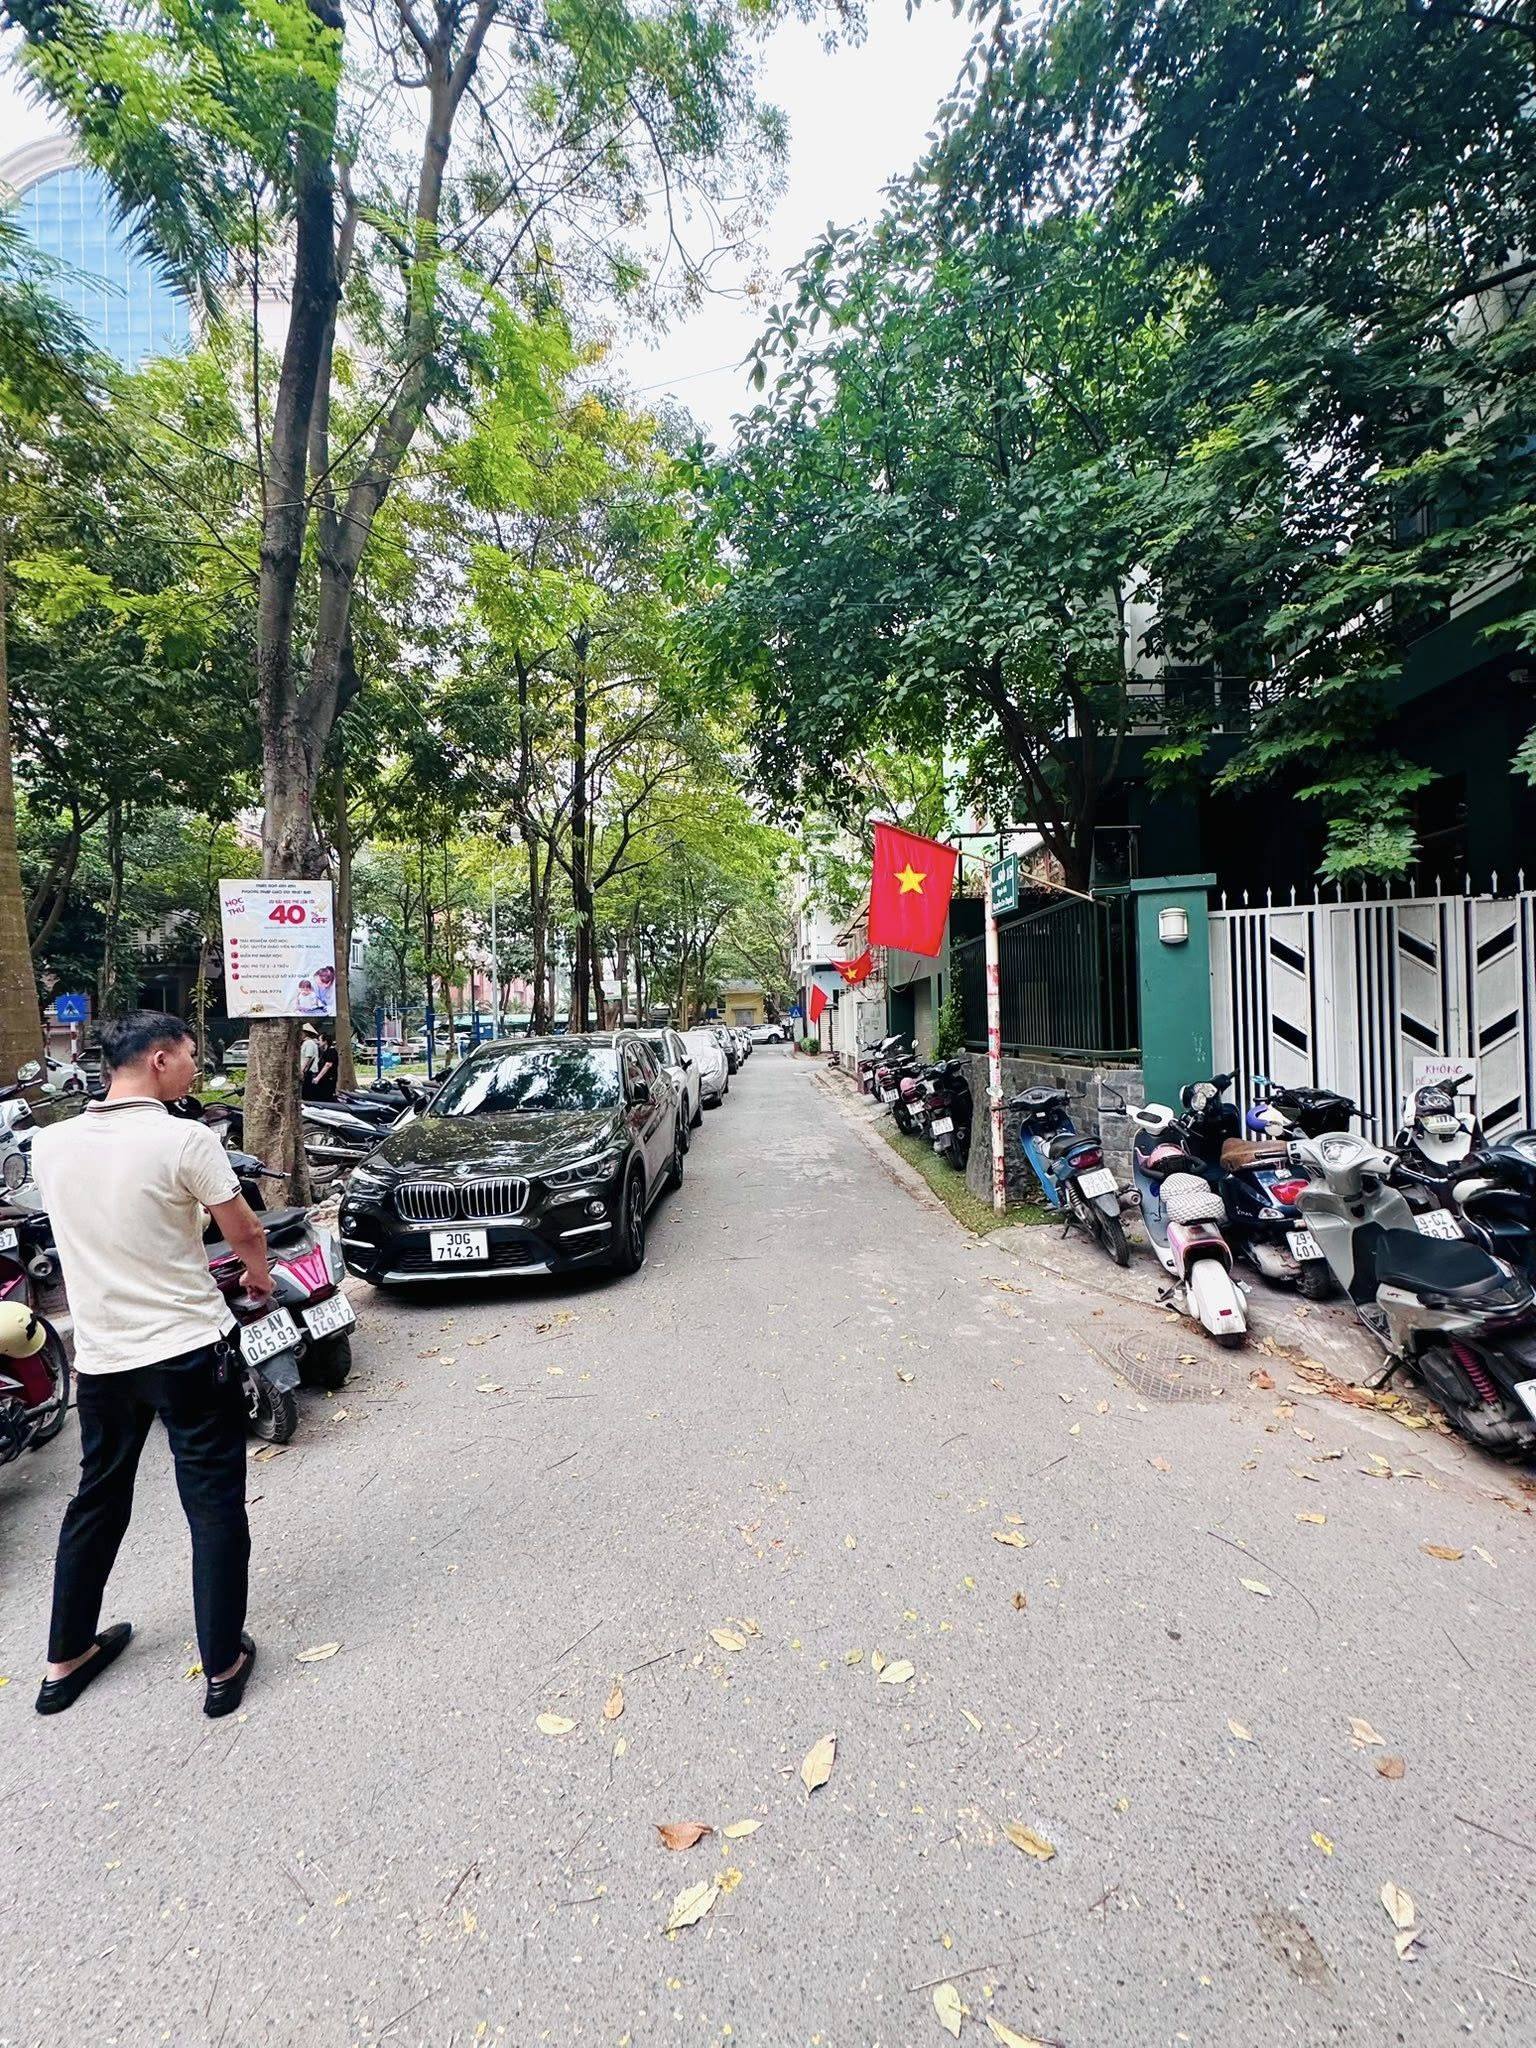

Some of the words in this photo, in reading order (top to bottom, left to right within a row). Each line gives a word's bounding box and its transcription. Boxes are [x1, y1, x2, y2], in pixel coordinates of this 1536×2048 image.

[224, 897, 243, 908] HỌC
[268, 905, 306, 924] 40
[1415, 1212, 1447, 1230] 9-CZ
[446, 1233, 471, 1246] 30G
[437, 1245, 480, 1259] 714.21
[309, 1297, 342, 1323] 29-BF
[243, 1313, 284, 1344] 36-AV
[312, 1308, 353, 1336] 149.12
[247, 1326, 297, 1361] 045.93
